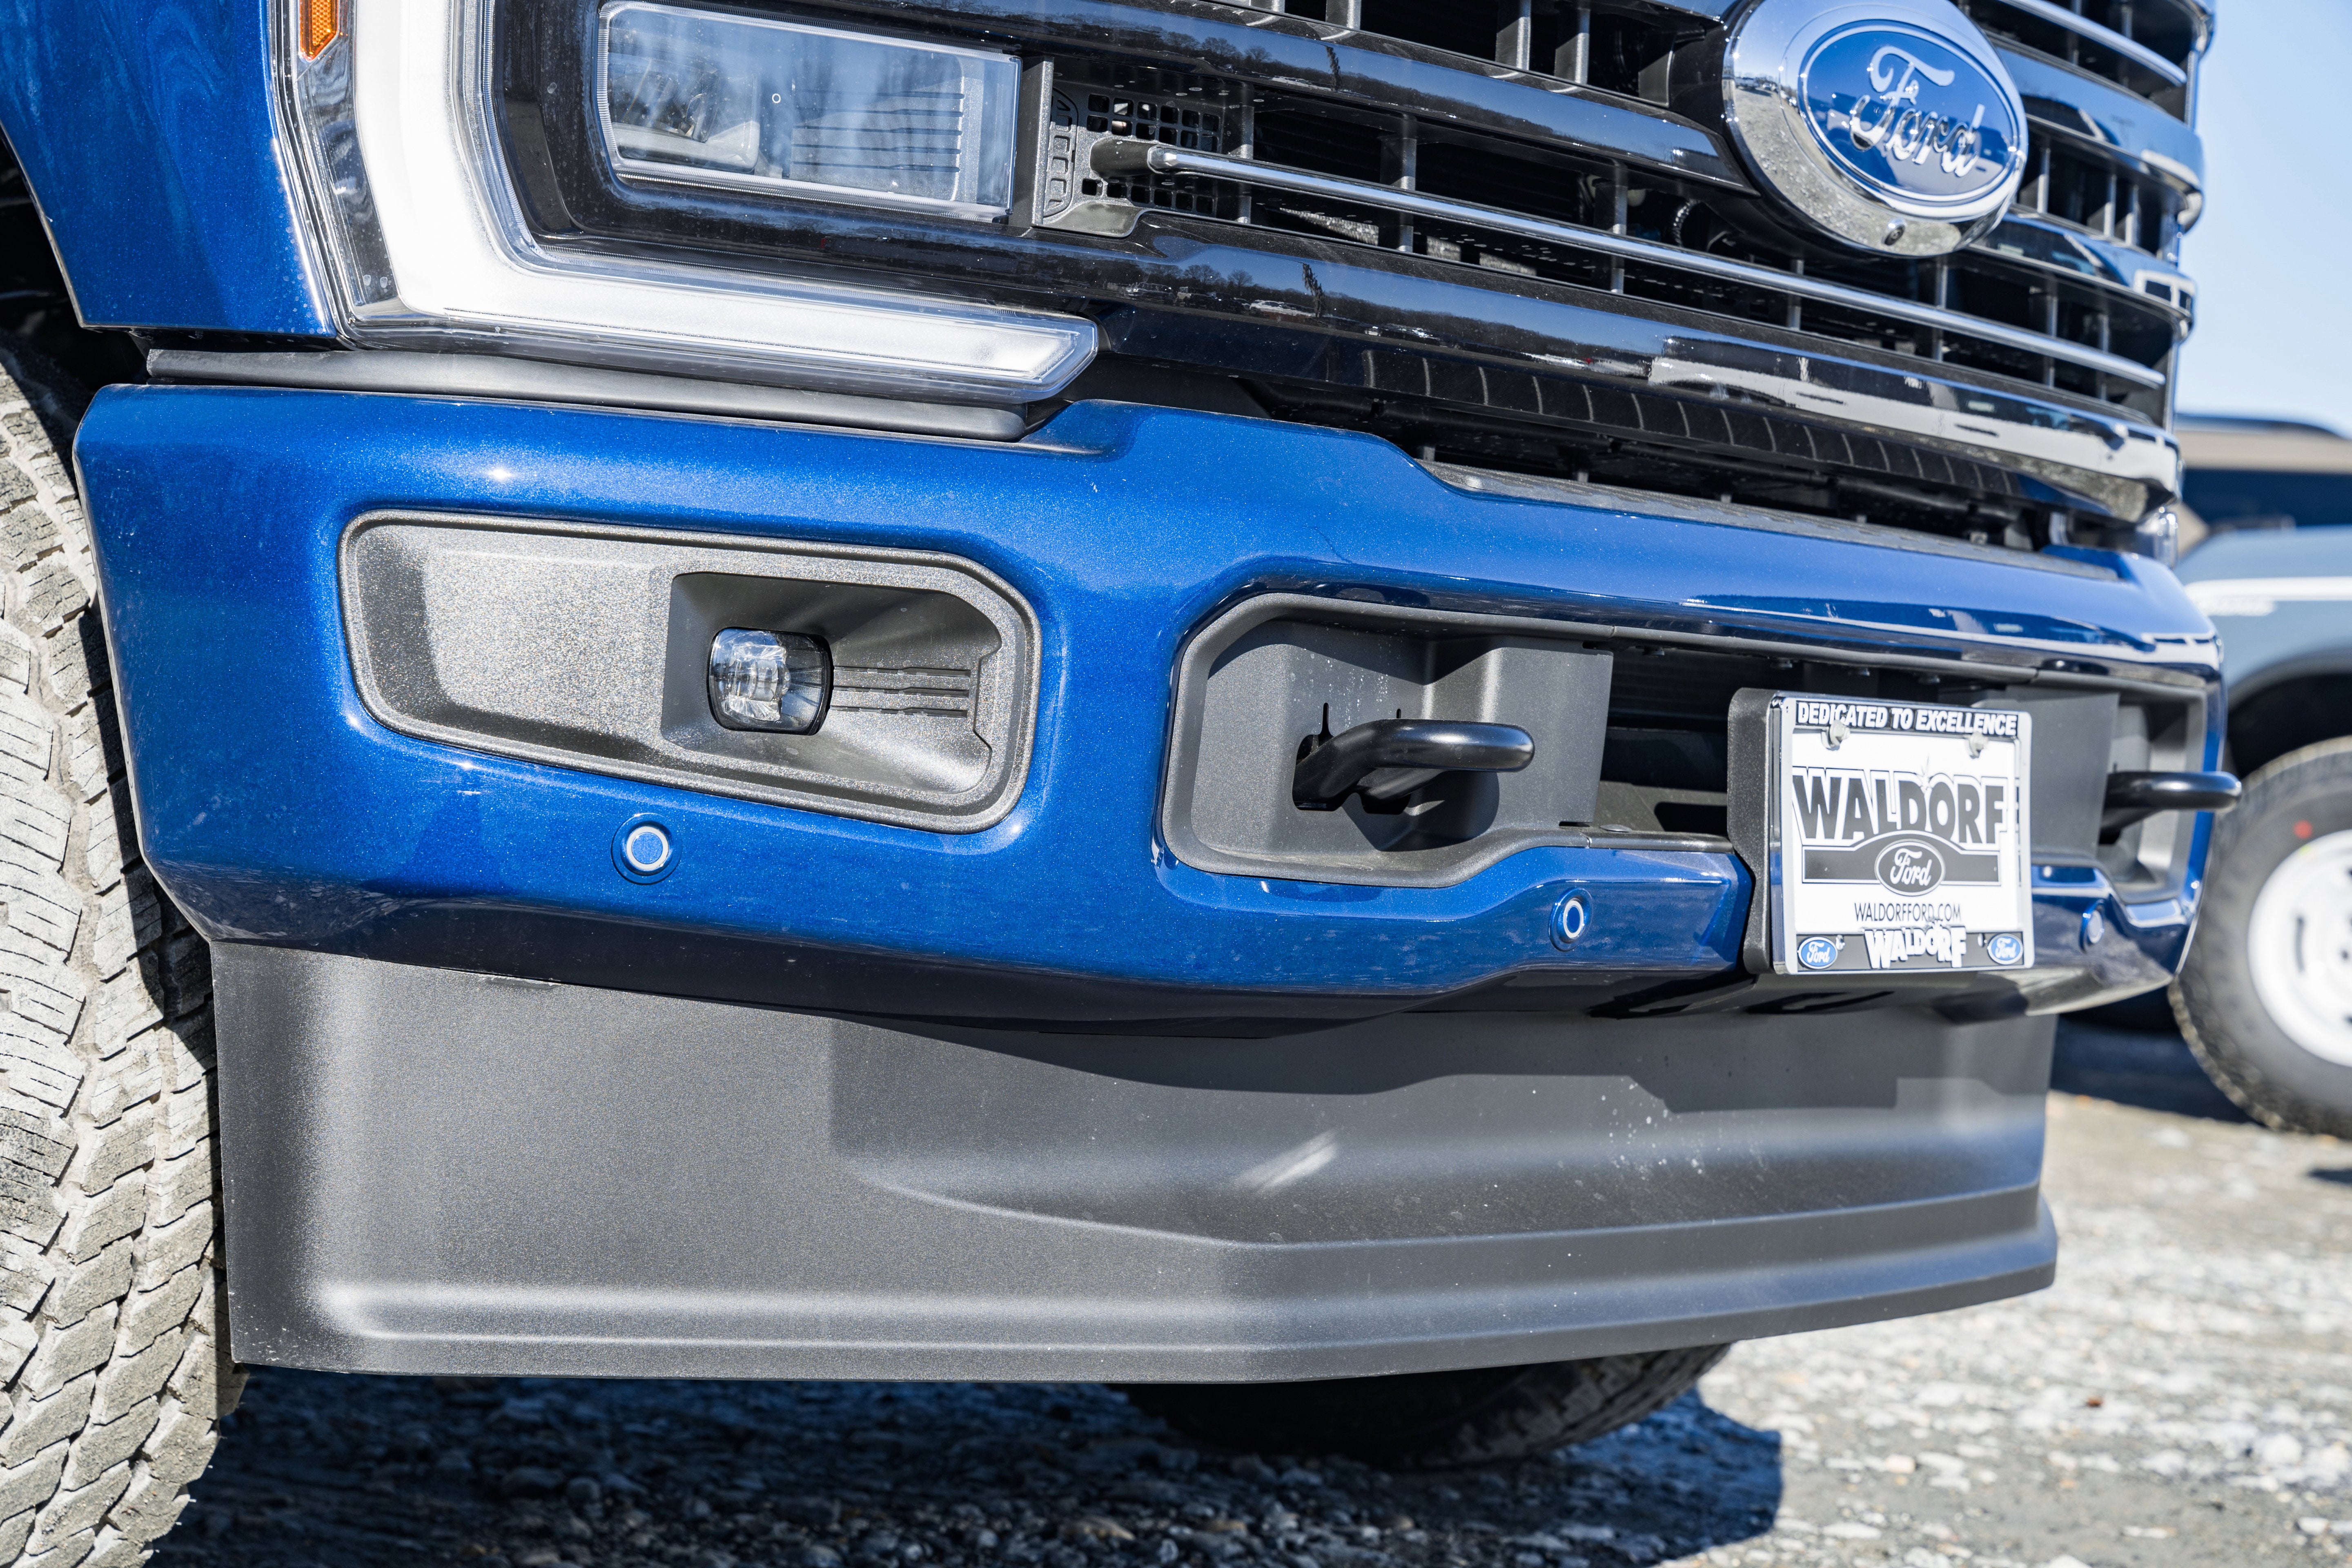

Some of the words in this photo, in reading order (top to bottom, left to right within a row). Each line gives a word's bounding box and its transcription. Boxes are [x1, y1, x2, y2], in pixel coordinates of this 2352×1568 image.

[1849, 45, 1985, 178] Ford
[1797, 702, 1888, 728] DEDICATED
[1891, 707, 1913, 730] TO
[1915, 710, 2018, 735] EXCELLENCE
[1793, 773, 2004, 845] WALDORF
[1890, 848, 1931, 886] Ford
[1807, 941, 1831, 964] Ford
[1864, 927, 1967, 969] WALDORF
[1995, 938, 2018, 959] Ford
